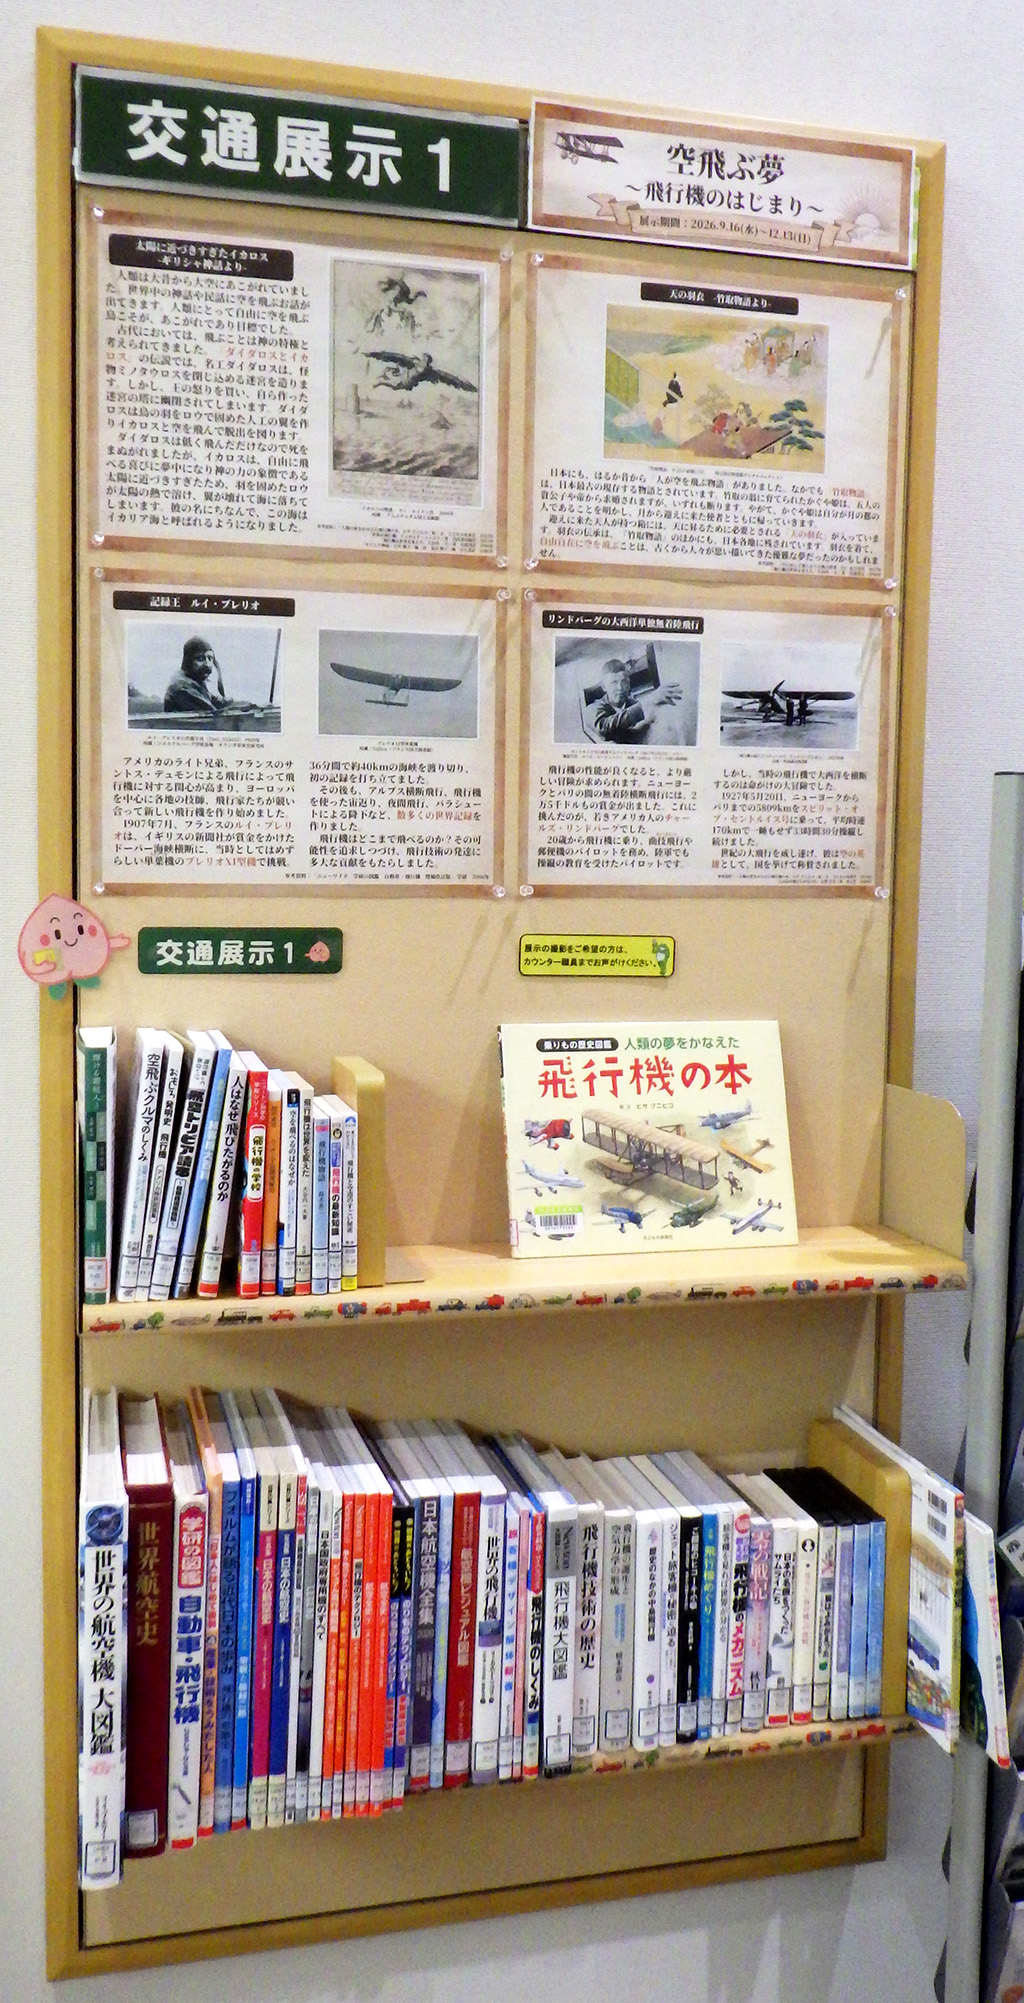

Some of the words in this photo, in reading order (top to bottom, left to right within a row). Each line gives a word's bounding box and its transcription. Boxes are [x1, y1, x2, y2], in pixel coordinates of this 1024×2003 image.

[126, 98, 452, 193] 交通展示1
[666, 142, 786, 184] 空飛ぶ夢
[135, 239, 269, 262] 太陽に近づきすぎたイカロス
[117, 269, 309, 298] 人類は大昔から大空にあこがれていまし
[105, 282, 310, 310] た。世界中の神話や民話に空を飛ぶお話が
[668, 288, 705, 302] 天の羽衣
[105, 297, 310, 324] 出てきます。人類にとって自由に空を飛ぶ
[105, 311, 294, 335] 鳥こそが、あこがれであり目標でした。
[117, 324, 309, 350] 古代においては、飛ぶことは神の特権と
[105, 364, 309, 389] 物ミノタウロスを閉じ込める迷宮を造りま
[106, 378, 309, 403] す。しかし、王の怒りを買い、自ら作った
[105, 391, 308, 415] 迷宮の塔に幽閉されてしまいます。ダイダ
[106, 405, 309, 429] ロスは鳥の羽をロウで固めた人工の翼を作
[106, 418, 300, 440] りイカロスと空を飛んで脱出を図ります。
[117, 433, 308, 456] ダイダロスは低く飛んだだけなので死を
[106, 446, 309, 469] まぬがれましたが、イカロスは、自由に飛
[105, 459, 309, 481] べる喜びに夢中になり神の力の象徴である
[106, 471, 308, 494] 太陽に近づきすぎたため、羽を固めたロウ
[105, 485, 308, 507] が太陽の熱で溶け、翼が壊れて海に落ちて
[106, 500, 308, 520] しまいます。彼の名にちなんで、この海は
[106, 513, 303, 533] イカリア海と呼ばれるようになりました。
[539, 548, 561, 559] せん。
[150, 596, 181, 608] 記録王
[190, 598, 261, 611] ルイ・ブレリオ
[548, 613, 701, 631] リンドバーグの大西洋単独無着陸飛行
[122, 757, 294, 770] アメリカのライト兄弟、フランスのサ
[548, 765, 692, 777] 飛行機の性能が良くなると、より厳
[722, 768, 868, 780] しかし、当時の飛行機で大西洋を横断
[113, 769, 295, 783] ントス・デュモンによる飛行によって飛
[309, 772, 429, 785] 初の記録を打ち立てました。
[539, 777, 691, 788] しい冒険が求められます。ニューヨー
[713, 780, 837, 791] するのは命がけの大冒険でした。
[113, 782, 295, 794] 行機に対する関心が高まり、ヨーロッパ
[112, 793, 295, 806] を中心に各地の技師、飛行家たちが競い
[309, 797, 482, 808] を使った宙返り、夜間飛行、パラシュー
[112, 806, 290, 819] 合って新しい飛行機を作り始めました。
[310, 809, 482, 822] トによる降下など、数多くの世界記録を
[538, 812, 691, 823] 挑んだのが、若きアメリカ人のチャー
[113, 831, 295, 844] オは、イギリスの新聞社が賞金をかけた
[309, 821, 362, 832] 作りました。
[538, 823, 650, 834] ルズ・リンドバーグでした。
[319, 834, 482, 845] 飛行機はどこまで飛べるのか？その可
[712, 837, 759, 847] 続けました。
[308, 845, 482, 857] 能性を追求しつづけ、飛行技術の発達に
[537, 847, 690, 858] 郵便機のパイロットを務め、陸軍でも
[309, 857, 439, 869] 多大な貢献をもたらしました。
[537, 858, 684, 869] 操縦の教育を受けたパイロットです。
[155, 938, 294, 967] 交通展示1
[524, 943, 629, 955] 展示の撮影をご希望の方は、
[523, 957, 657, 968] カウンター職員までお声がけください。
[543, 1039, 613, 1050] 乗りもの歴史図鑑
[624, 1036, 741, 1050] 人類の夢をかなえた
[538, 1053, 753, 1100] 飛行機の本
[138, 1053, 161, 1162] 空飛ぶクルマのしくみ
[217, 1076, 244, 1203] 人はなぜ飛びたがるのか
[287, 1110, 298, 1187] 空を飛べるのはなぜか
[301, 1098, 312, 1178] 飛行機は世界を変えた
[250, 1135, 264, 1192] 飛行機の学校
[331, 1167, 341, 1236] 飛行機の最新知識
[417, 1500, 438, 1626] 日本航空機全集
[135, 1521, 162, 1647] 世界航空史
[483, 1535, 501, 1622] 世界の飛行機
[773, 1553, 783, 1605] サムライたち
[278, 1556, 292, 1625] 日本の航空史
[580, 1523, 599, 1670] 飛行機技術の歴史
[457, 1547, 473, 1667] 航空機ビジュアル図鑑
[552, 1581, 570, 1681] 飛行機大図鑑
[729, 1563, 748, 1697] 飛行機のメカニズム
[90, 1550, 117, 1757] 世界の航空機大図鑑
[173, 1595, 203, 1725] 自動車・飛行機
[528, 1595, 543, 1710] 飛行機のしくみ
